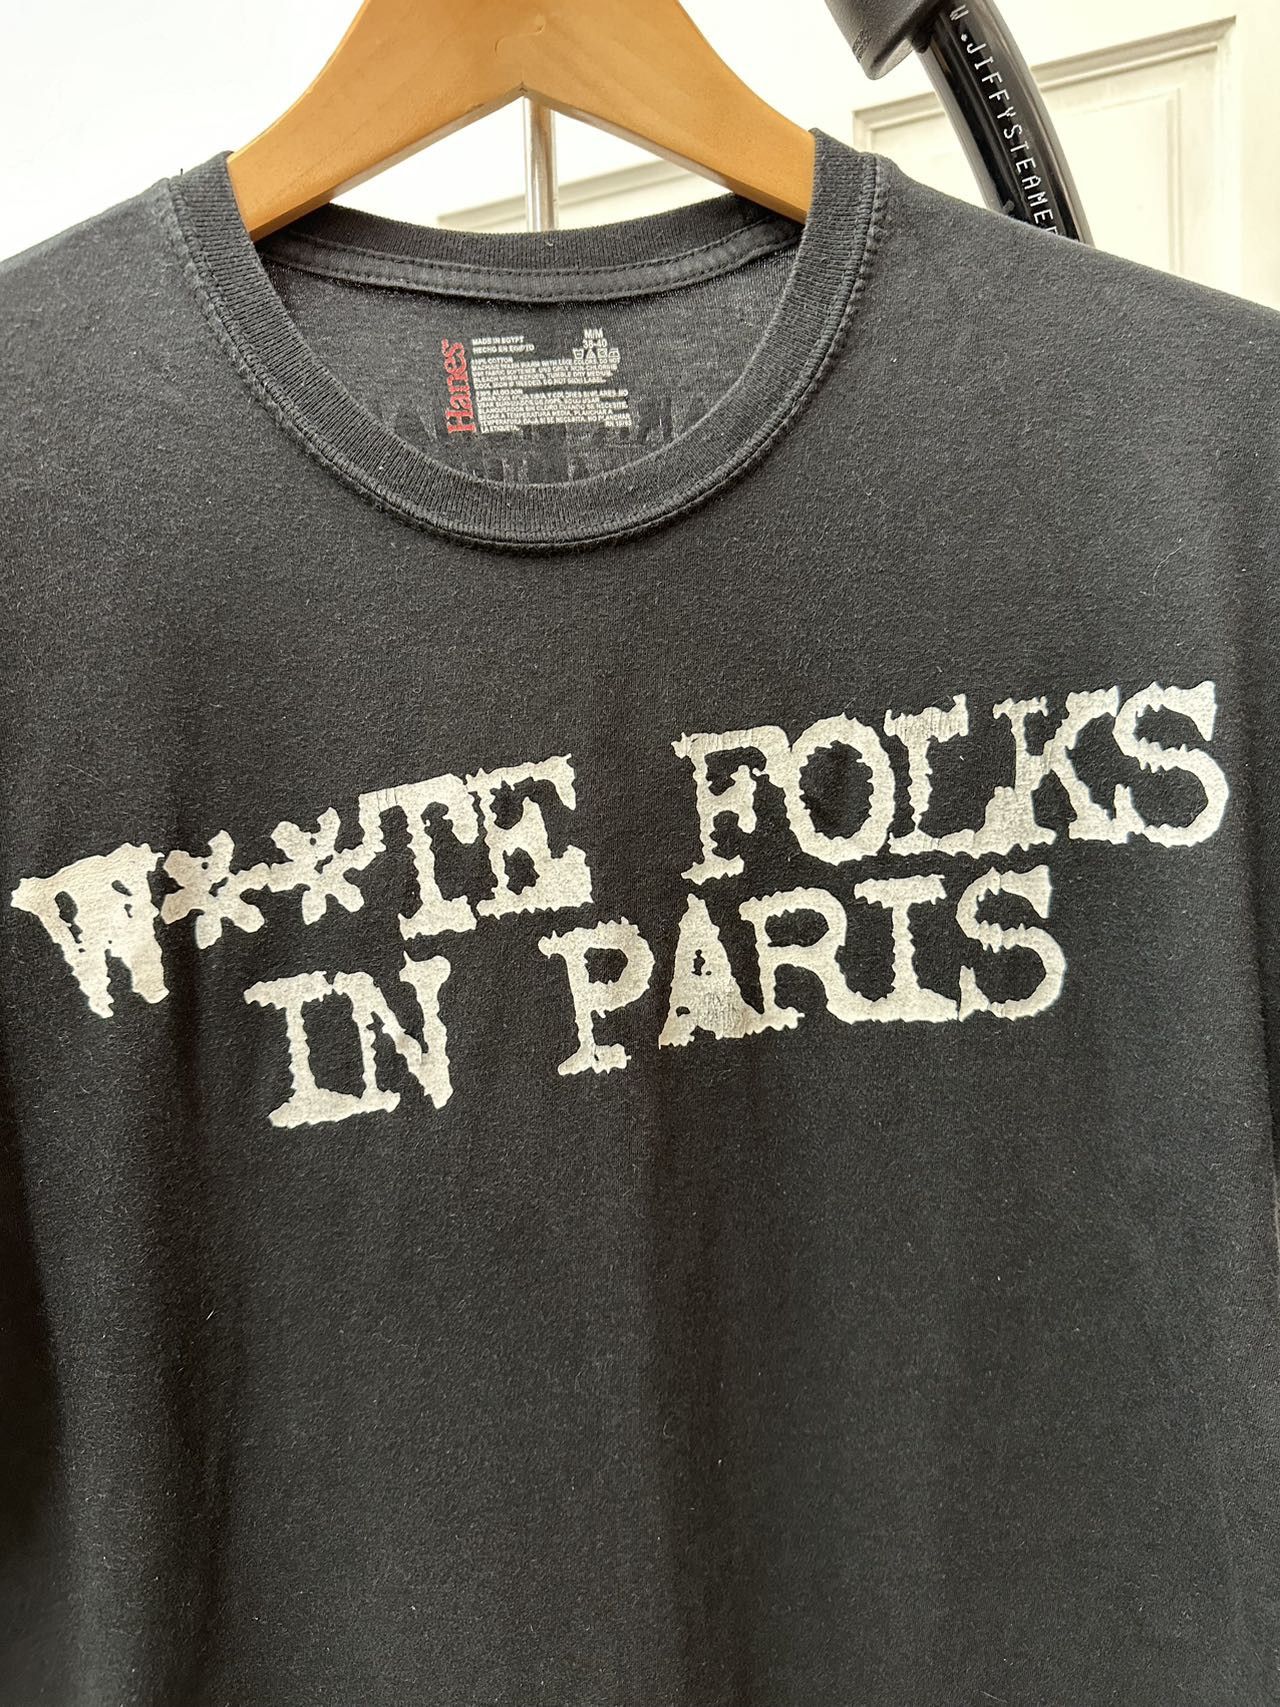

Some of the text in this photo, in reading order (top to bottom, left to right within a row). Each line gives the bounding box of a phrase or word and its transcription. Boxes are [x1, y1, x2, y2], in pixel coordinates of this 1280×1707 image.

[584, 328, 603, 339] M/M
[501, 336, 524, 344] EGYPT
[583, 338, 607, 349] 38-40
[473, 346, 497, 354] HECHO
[442, 338, 476, 434] Hanes
[671, 681, 1229, 885] FOLKS
[244, 865, 1067, 1128] IN PARIS
